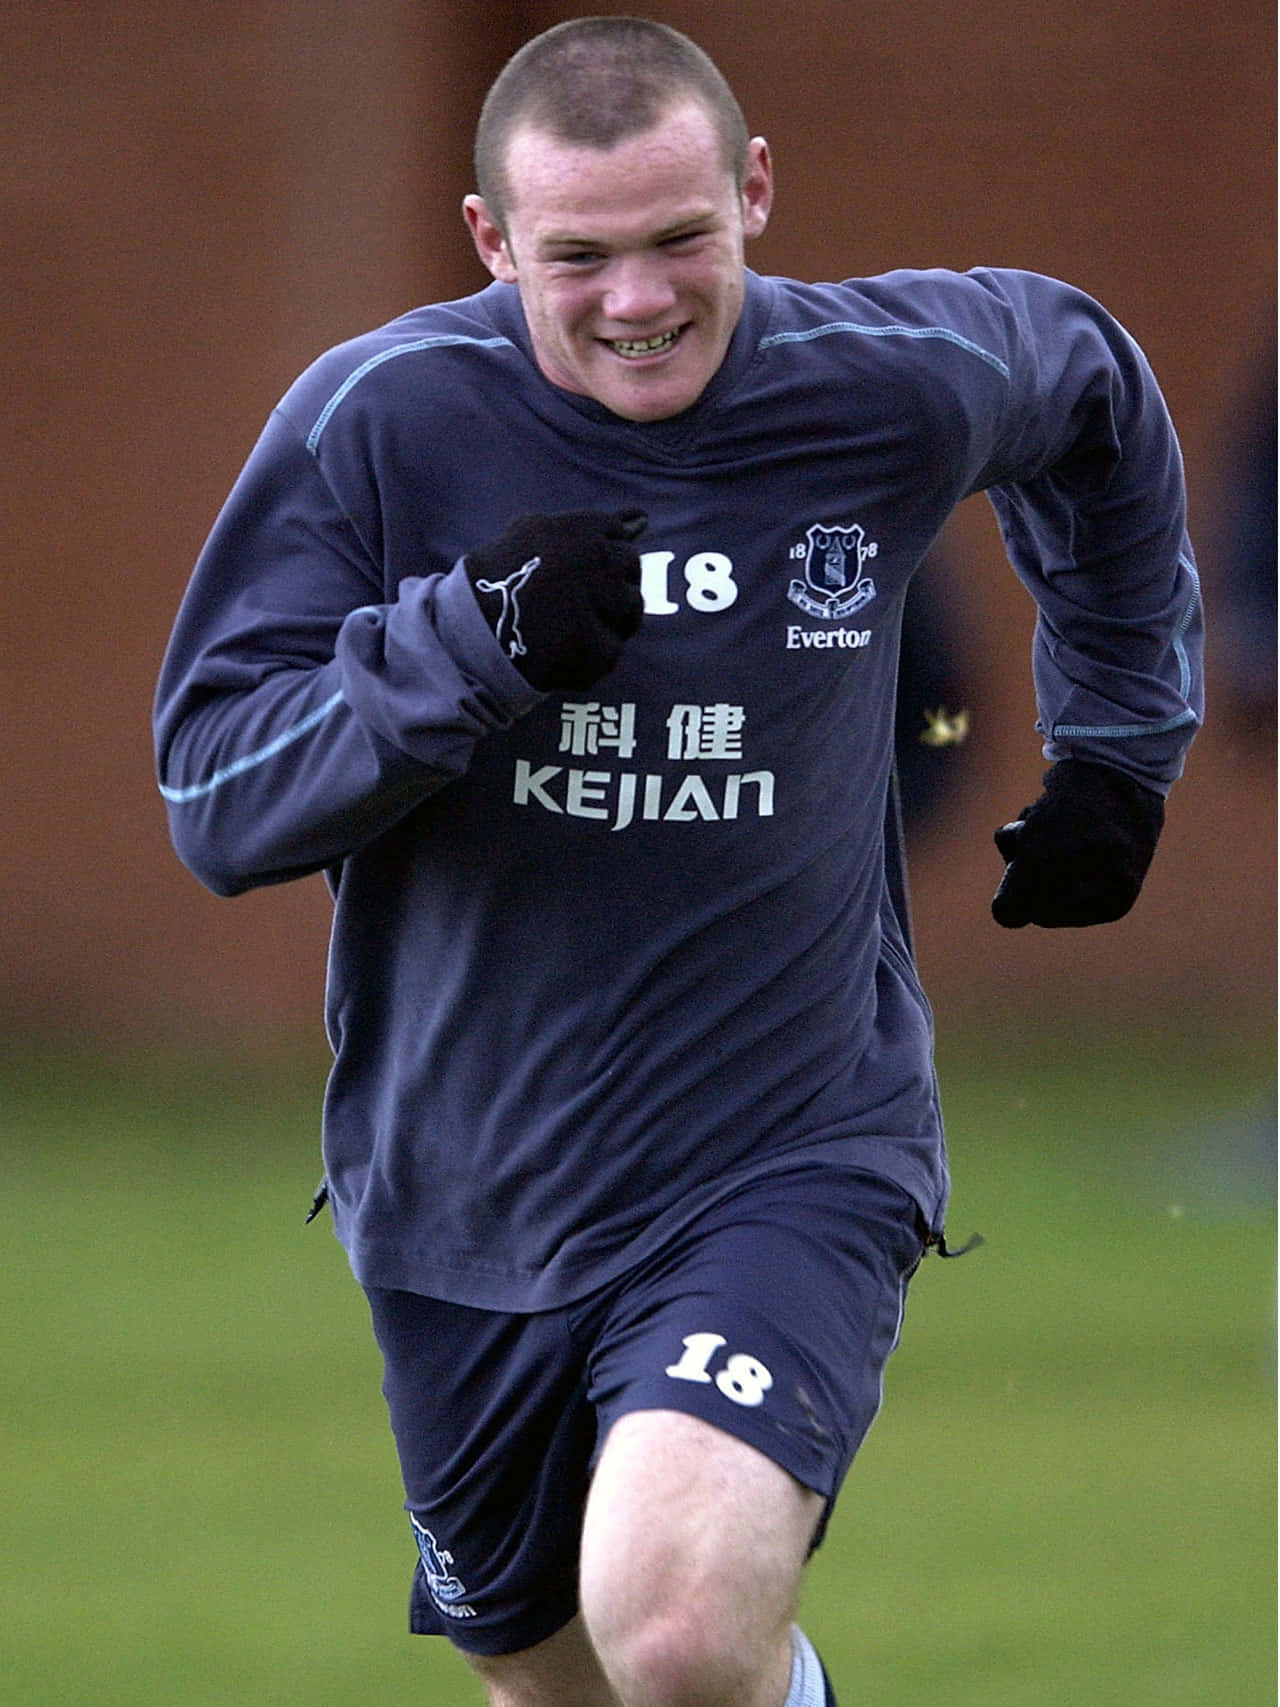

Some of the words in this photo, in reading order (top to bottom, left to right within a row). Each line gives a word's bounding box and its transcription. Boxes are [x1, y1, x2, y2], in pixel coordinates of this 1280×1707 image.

[640, 550, 739, 615] 18
[789, 543, 806, 559] 18
[861, 542, 878, 562] 78
[786, 625, 872, 649] Everton
[558, 701, 745, 760] 科健
[512, 759, 775, 831] KEJIAN
[665, 1332, 773, 1407] 18
